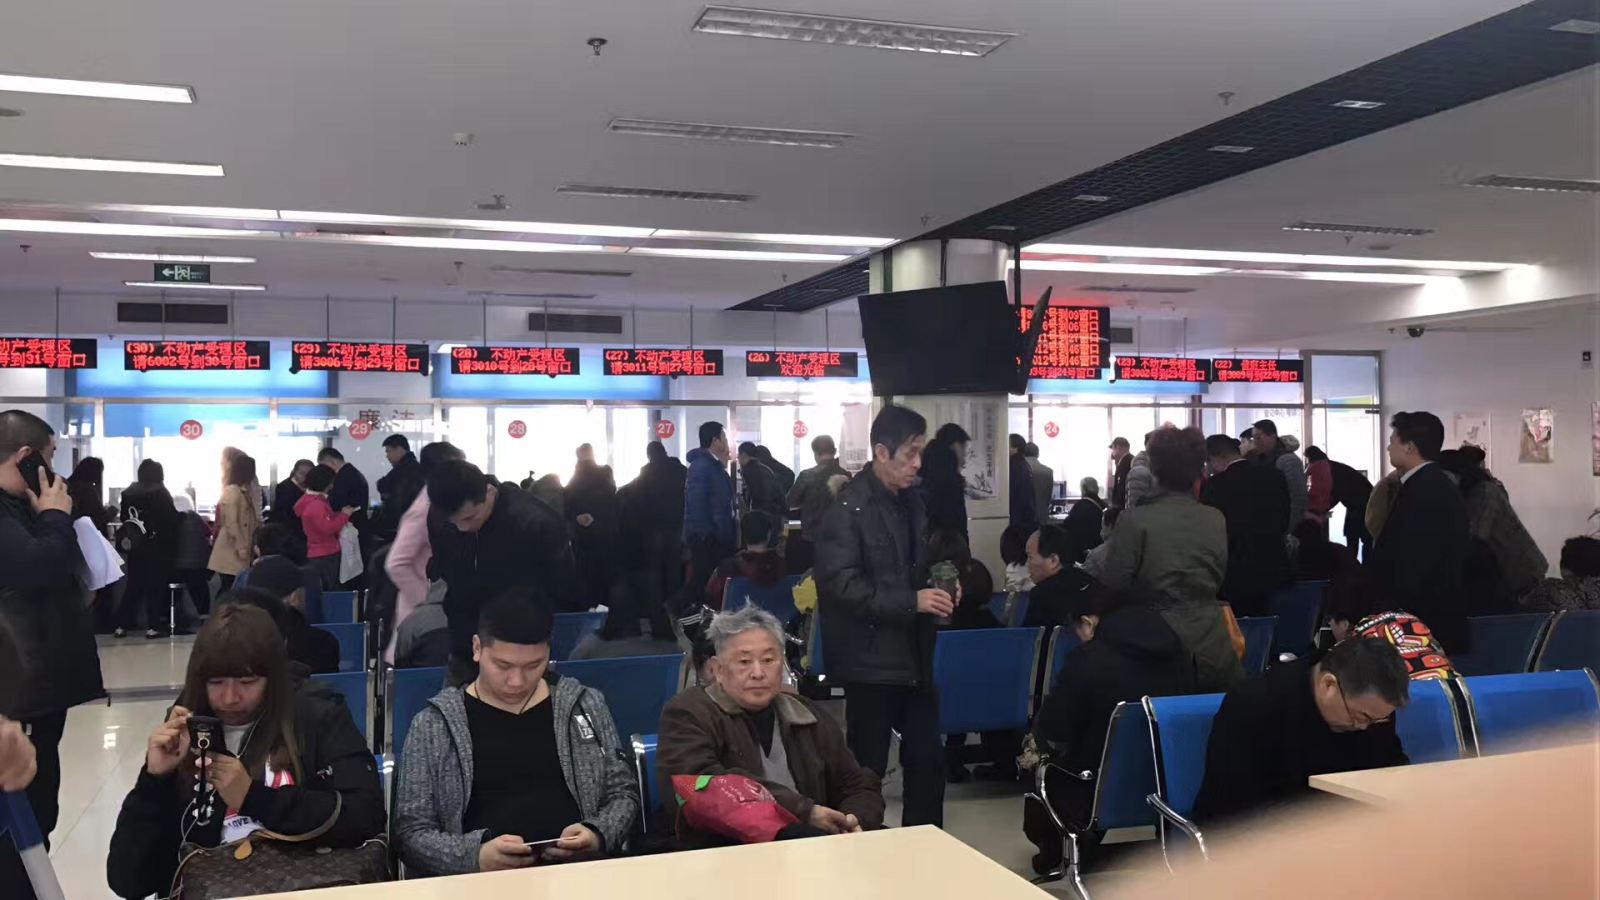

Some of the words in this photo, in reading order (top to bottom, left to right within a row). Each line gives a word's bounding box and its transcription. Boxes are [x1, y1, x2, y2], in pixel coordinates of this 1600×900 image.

[127, 343, 154, 353] (30)
[161, 341, 247, 355] 不动产受理区
[294, 343, 320, 354] (29)
[327, 343, 407, 357] 不动产受理区
[453, 348, 478, 358] (28)
[490, 347, 566, 361] 不动产受理区
[133, 355, 260, 369] 请6002号到30号窗口
[606, 350, 629, 360] (27)
[635, 350, 704, 362] 不动产受理区
[748, 353, 770, 362] (26)
[775, 352, 840, 365] 不动产受理区
[300, 355, 420, 371] 请3006号到29号窗口
[458, 360, 571, 374] 请3010号到28号窗口
[611, 361, 716, 374] 请3011号到27号窗口
[1117, 358, 1136, 367] (23)
[1140, 357, 1196, 371] 不动产受理区
[1215, 360, 1232, 369] (22)
[781, 364, 825, 376] 欢迎光临
[183, 424, 199, 436] 30
[351, 423, 368, 435] 29
[510, 424, 525, 435] 28
[658, 423, 671, 434] 27
[794, 424, 807, 434] 26
[1046, 424, 1057, 434] 24
